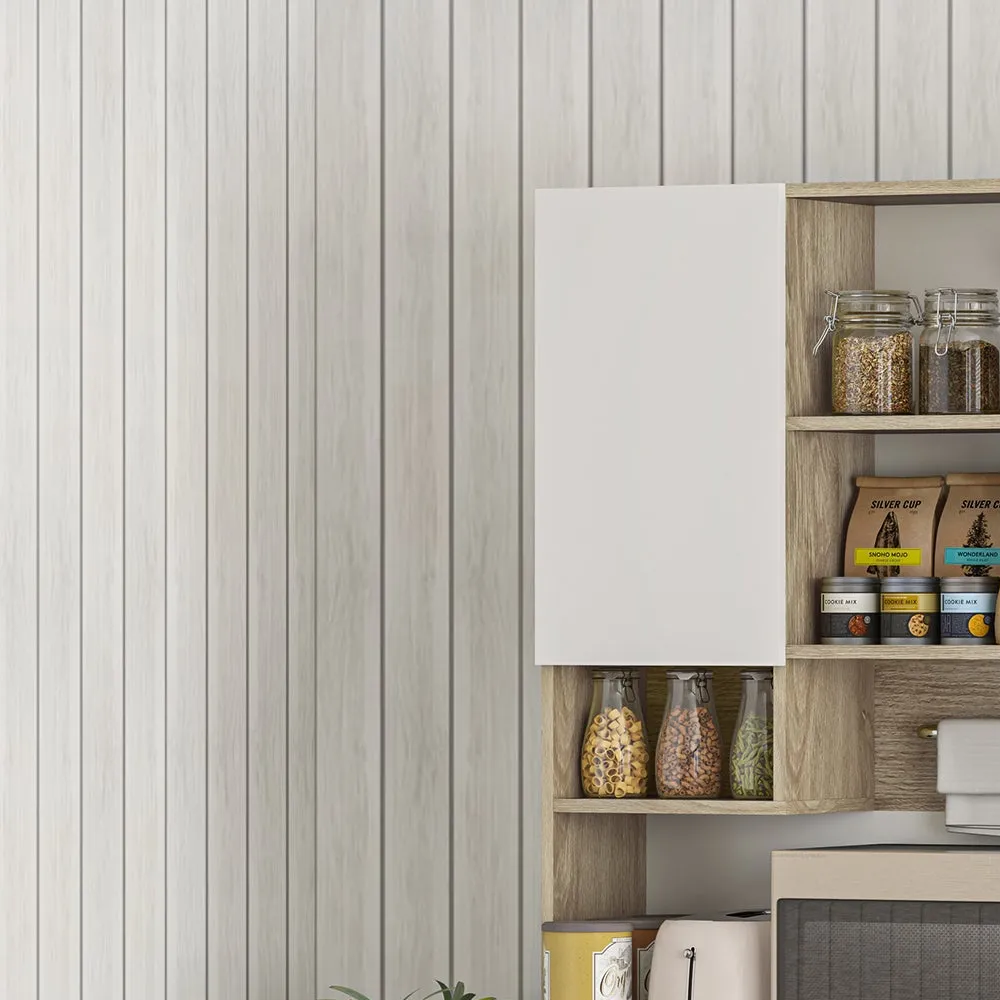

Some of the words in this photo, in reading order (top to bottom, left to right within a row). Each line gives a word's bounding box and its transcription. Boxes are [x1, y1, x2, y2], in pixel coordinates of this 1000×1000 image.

[870, 499, 901, 509] SILVER
[903, 499, 922, 509] CUP
[961, 499, 992, 509] SILVER
